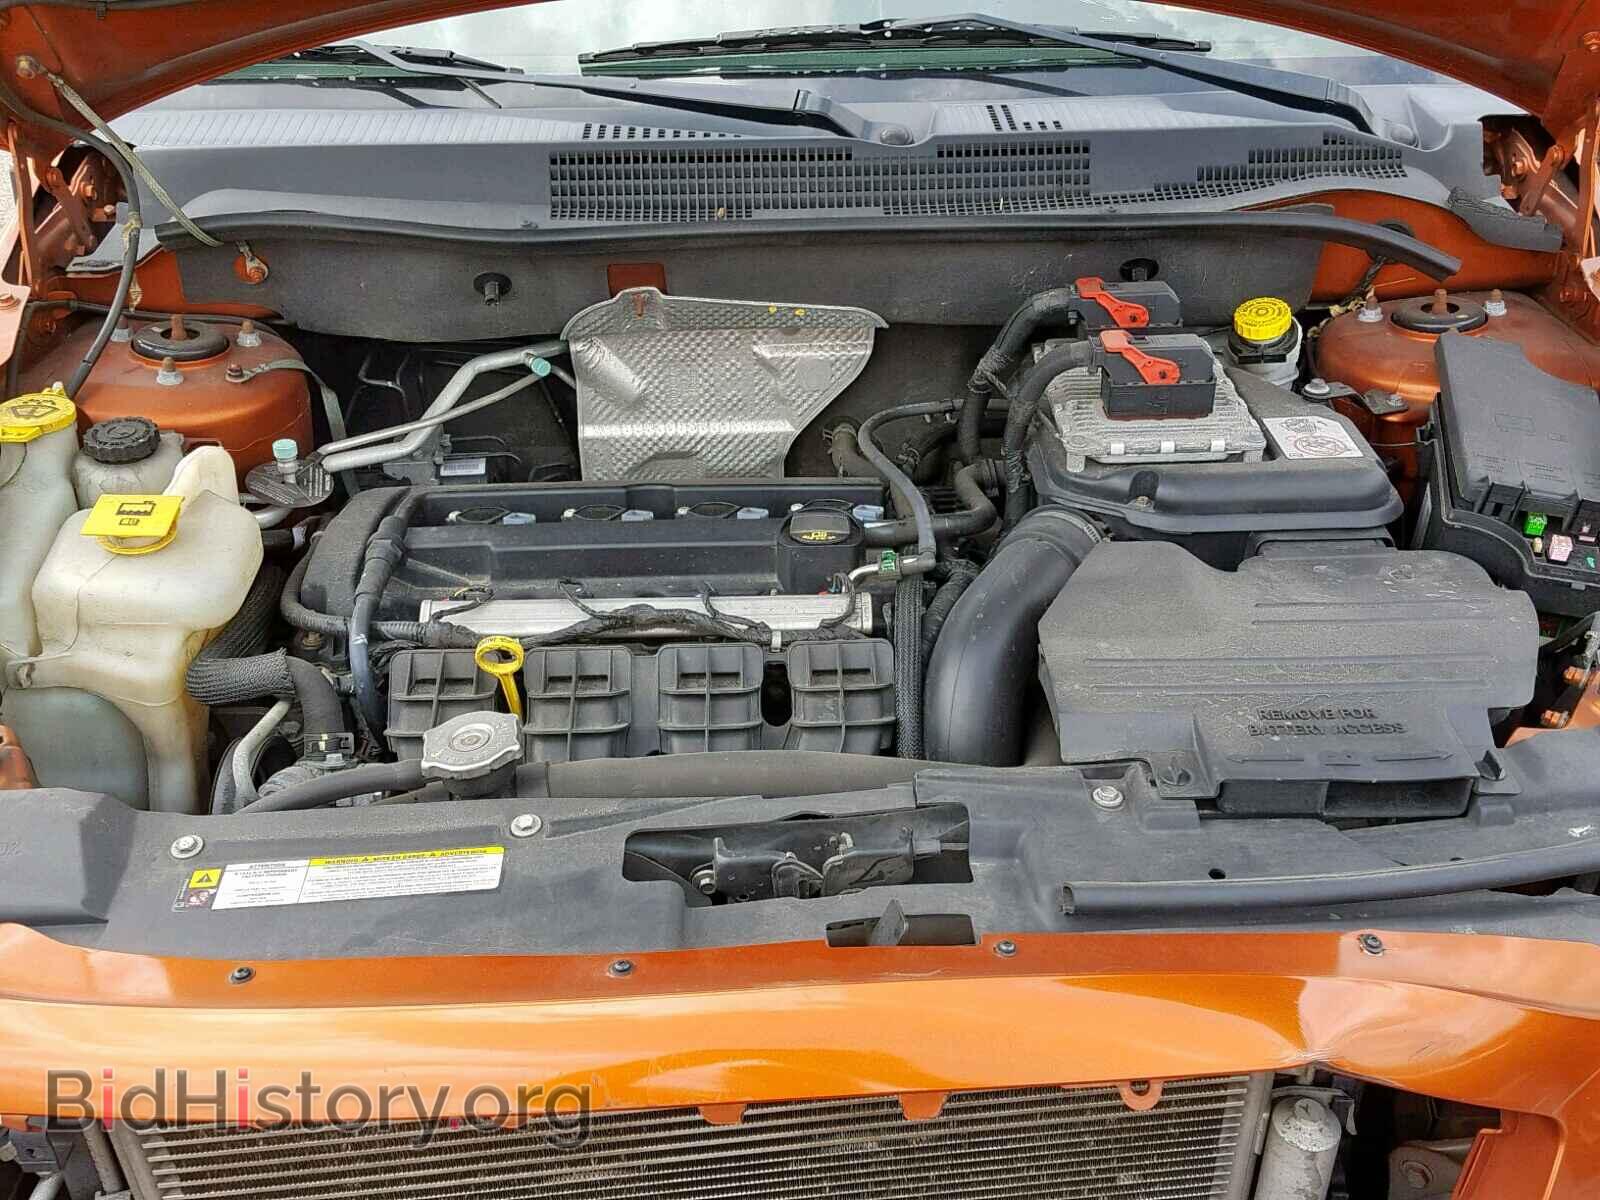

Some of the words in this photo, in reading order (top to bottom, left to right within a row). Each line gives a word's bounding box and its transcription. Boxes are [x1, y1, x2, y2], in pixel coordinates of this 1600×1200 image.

[1257, 708, 1336, 721] REMOVE
[1339, 707, 1378, 720] FOR
[1249, 723, 1325, 737] BATTERY
[1334, 722, 1406, 735] ACCESS
